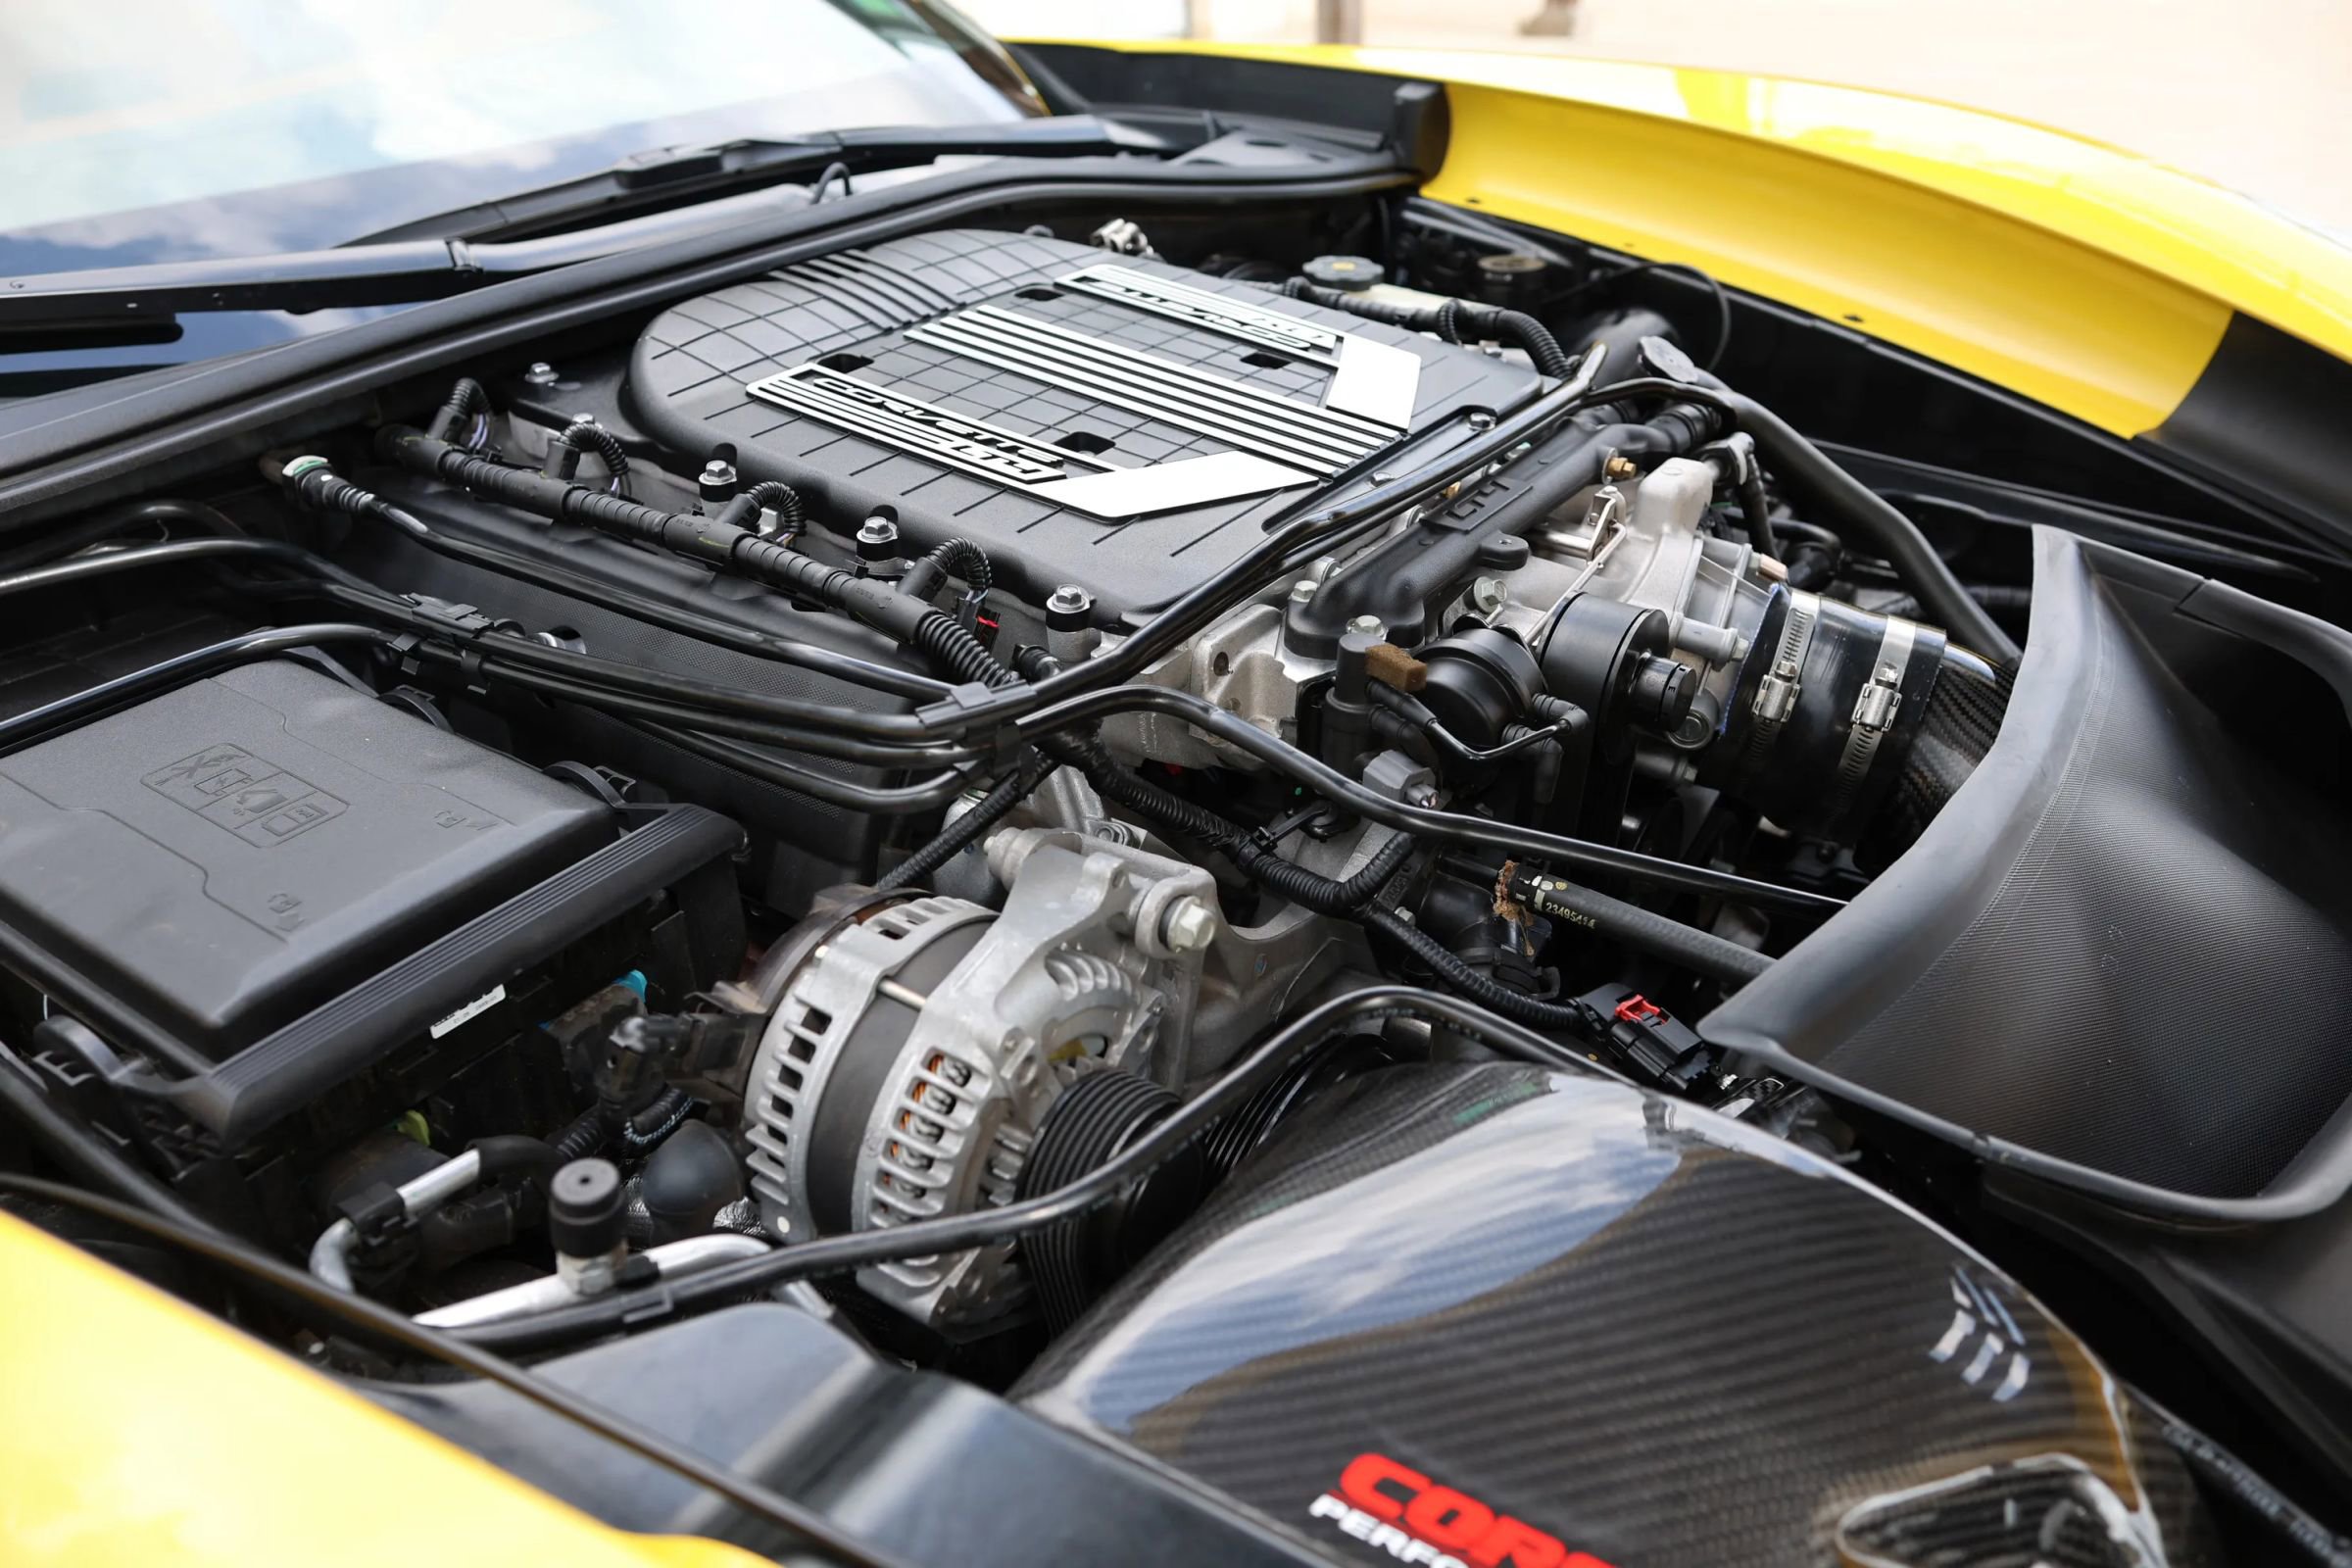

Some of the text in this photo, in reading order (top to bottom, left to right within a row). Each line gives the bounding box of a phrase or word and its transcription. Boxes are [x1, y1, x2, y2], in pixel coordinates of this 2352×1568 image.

[813, 377, 1064, 466] CORVETTE
[952, 445, 1043, 474] LT4
[1443, 478, 1510, 520] LT4
[1339, 1451, 1623, 1568] COR
